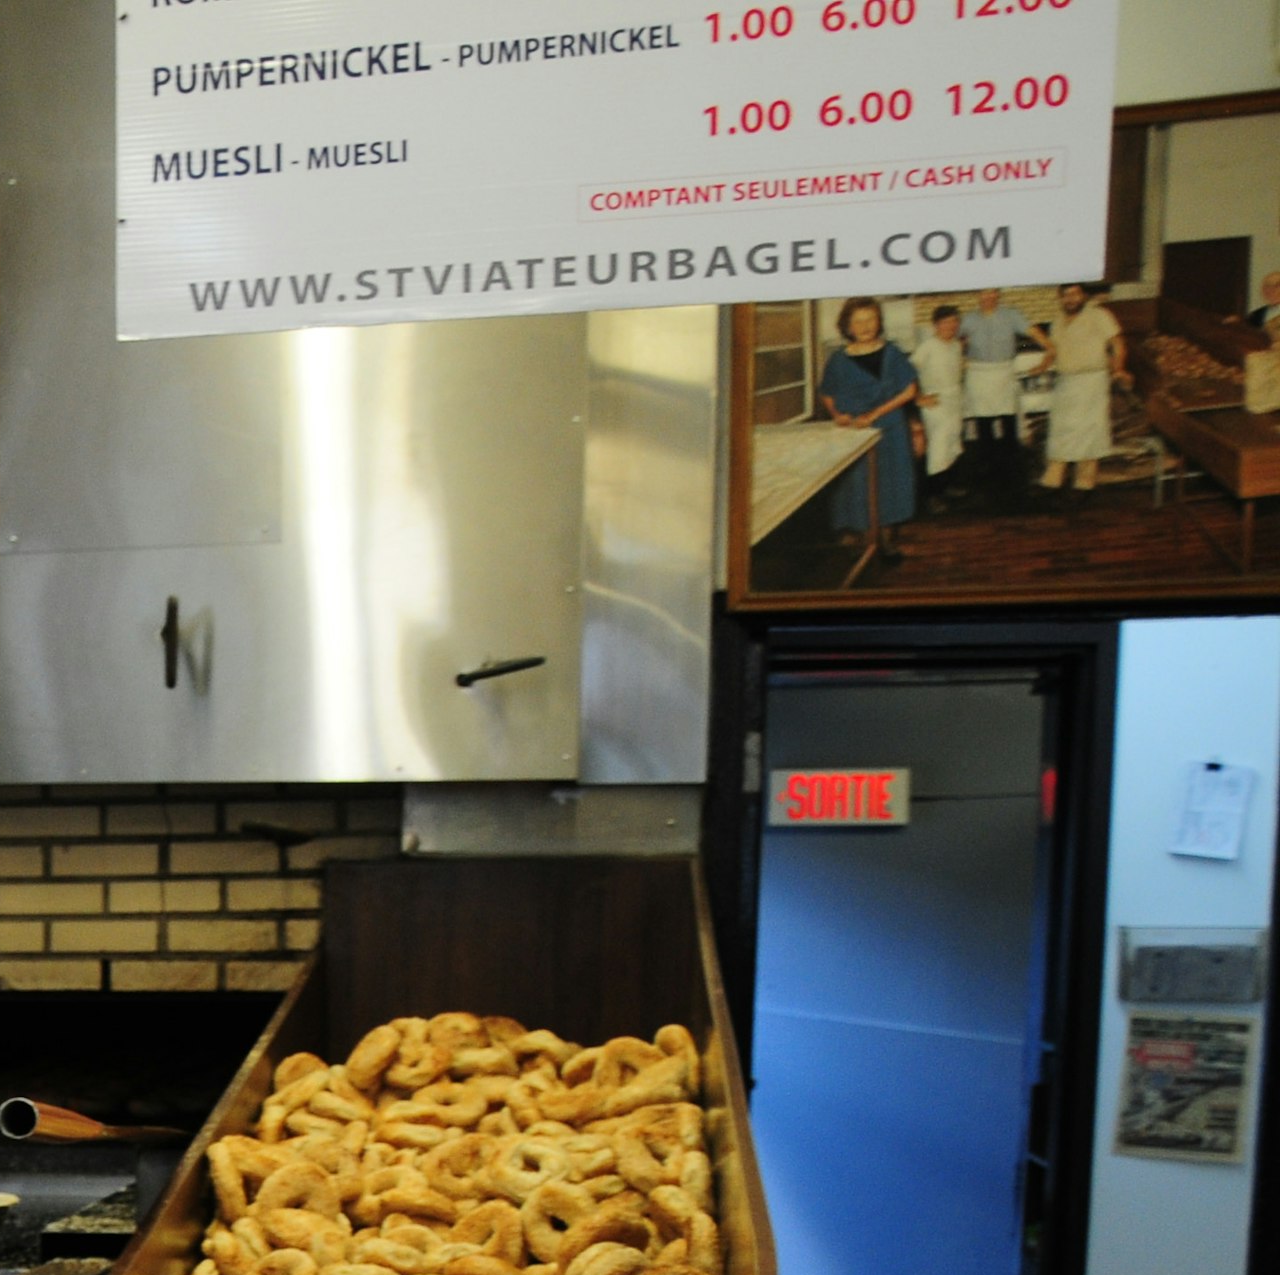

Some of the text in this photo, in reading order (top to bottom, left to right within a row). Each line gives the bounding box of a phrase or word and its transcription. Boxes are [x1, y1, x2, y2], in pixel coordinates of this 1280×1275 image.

[152, 41, 431, 97] PUMPERNICKEL
[458, 25, 680, 68] PUMPERNICKEL
[704, 6, 794, 44] 1.00
[821, 0, 916, 33] 6.00
[953, 0, 1072, 20] 12.
[152, 143, 283, 183] MUESLI
[307, 139, 409, 170] MUESLI
[702, 100, 792, 137] 1.00
[819, 89, 914, 126] 6.00
[946, 74, 1069, 116] 12.00
[590, 183, 725, 211] COMPTANT
[733, 172, 882, 201] SEULEMENT
[905, 163, 975, 189] CASH
[982, 157, 1054, 183] ONLY
[190, 226, 1014, 313] WWW.STVIATEURBAGEL.COM
[786, 773, 896, 821] SORTIE
